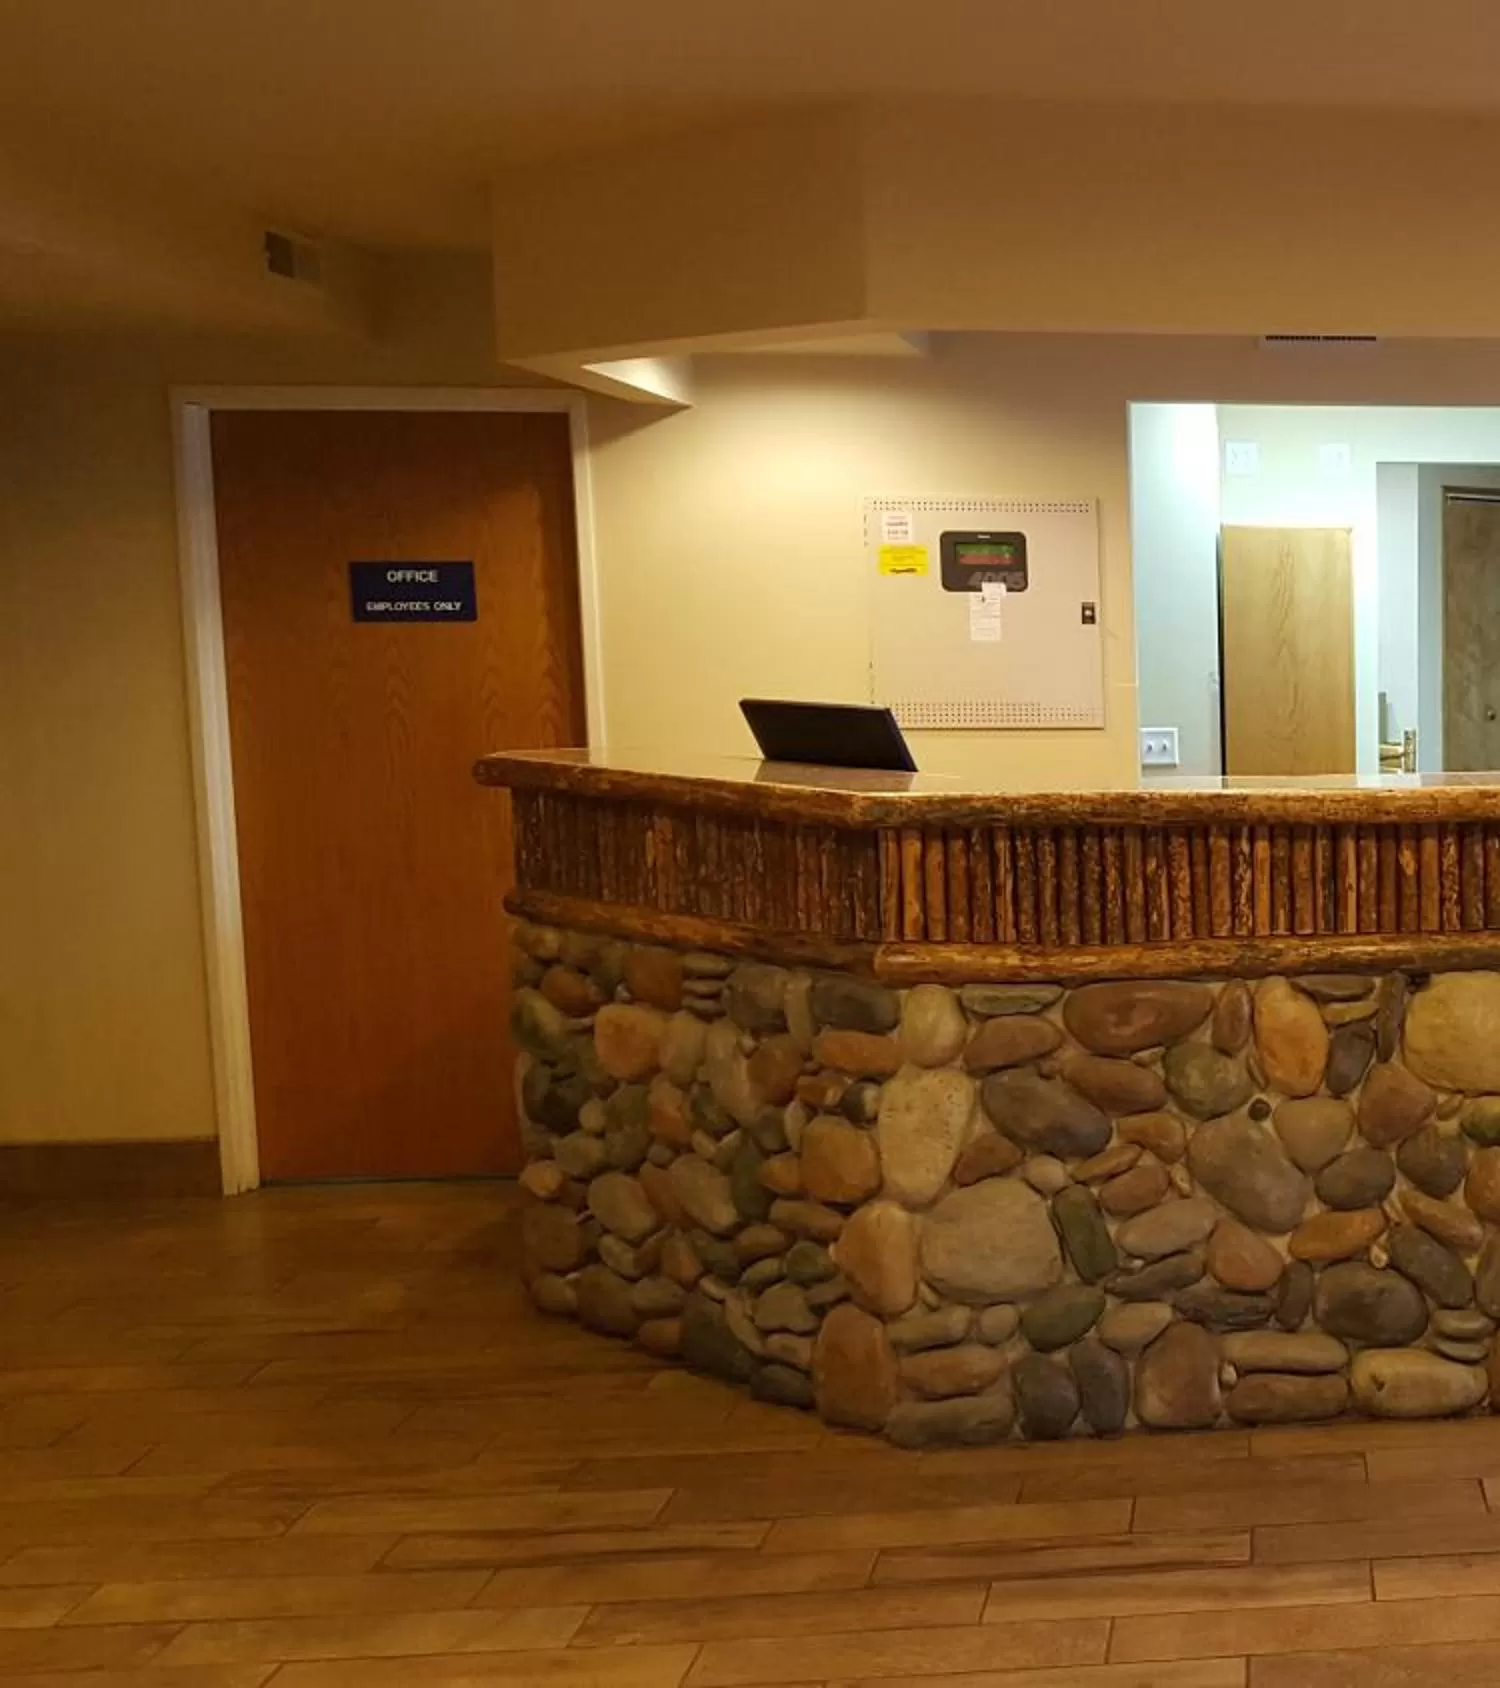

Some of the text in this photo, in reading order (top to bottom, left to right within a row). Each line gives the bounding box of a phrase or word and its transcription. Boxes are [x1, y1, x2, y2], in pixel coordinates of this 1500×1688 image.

[386, 569, 440, 583] OFFICE
[365, 601, 462, 612] EMPLOYEES ONLY
